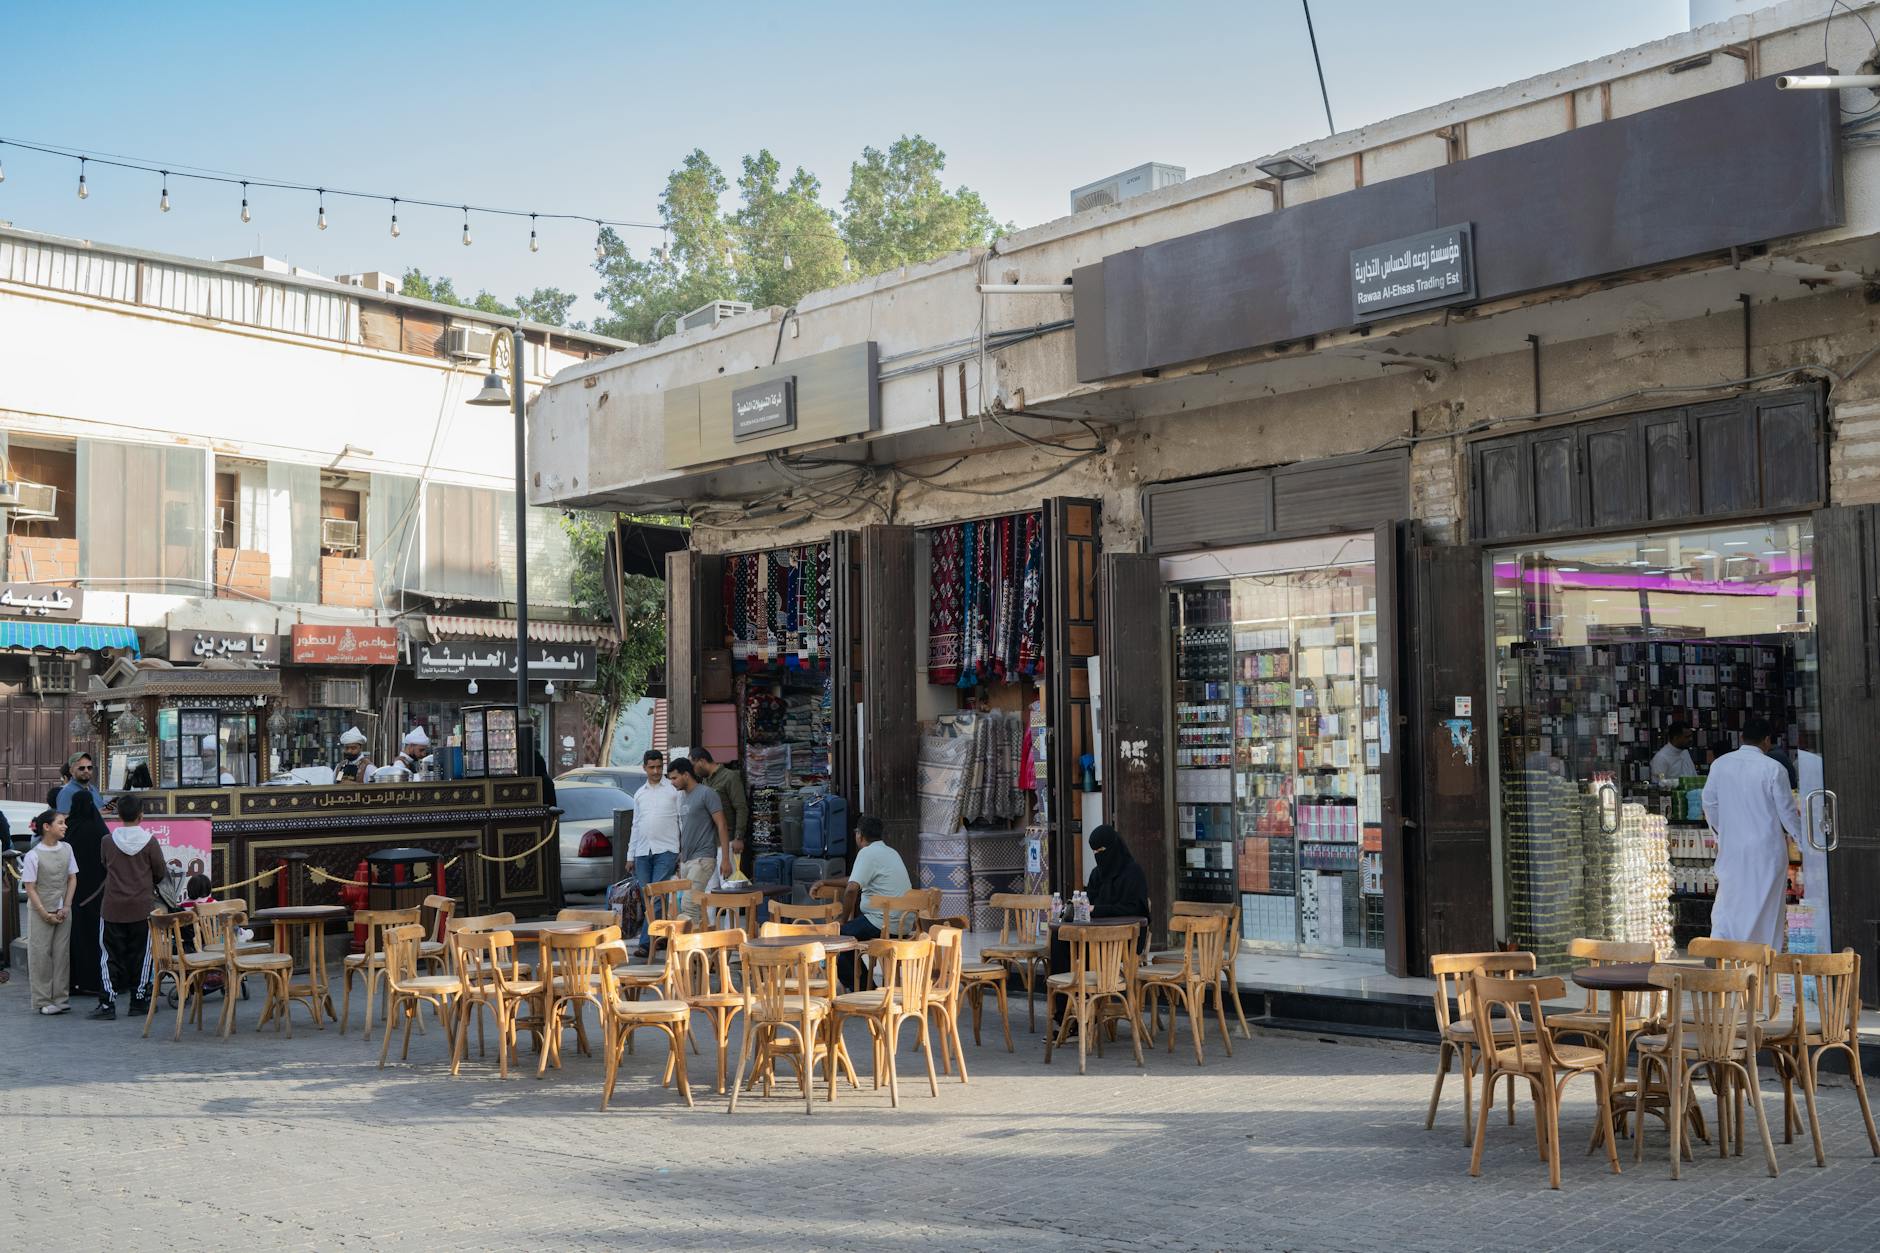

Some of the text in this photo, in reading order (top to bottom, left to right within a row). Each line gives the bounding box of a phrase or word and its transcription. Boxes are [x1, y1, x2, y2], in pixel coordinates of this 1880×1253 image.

[1430, 237, 1460, 264] مؤسسة
[1355, 258, 1380, 283] التجارية
[1357, 271, 1460, 304] Rawaa Al-Ehsas Trading Est
[296, 634, 337, 647] للعطور
[421, 646, 585, 674] العطر الحديثة
[320, 792, 361, 807] الجميل
